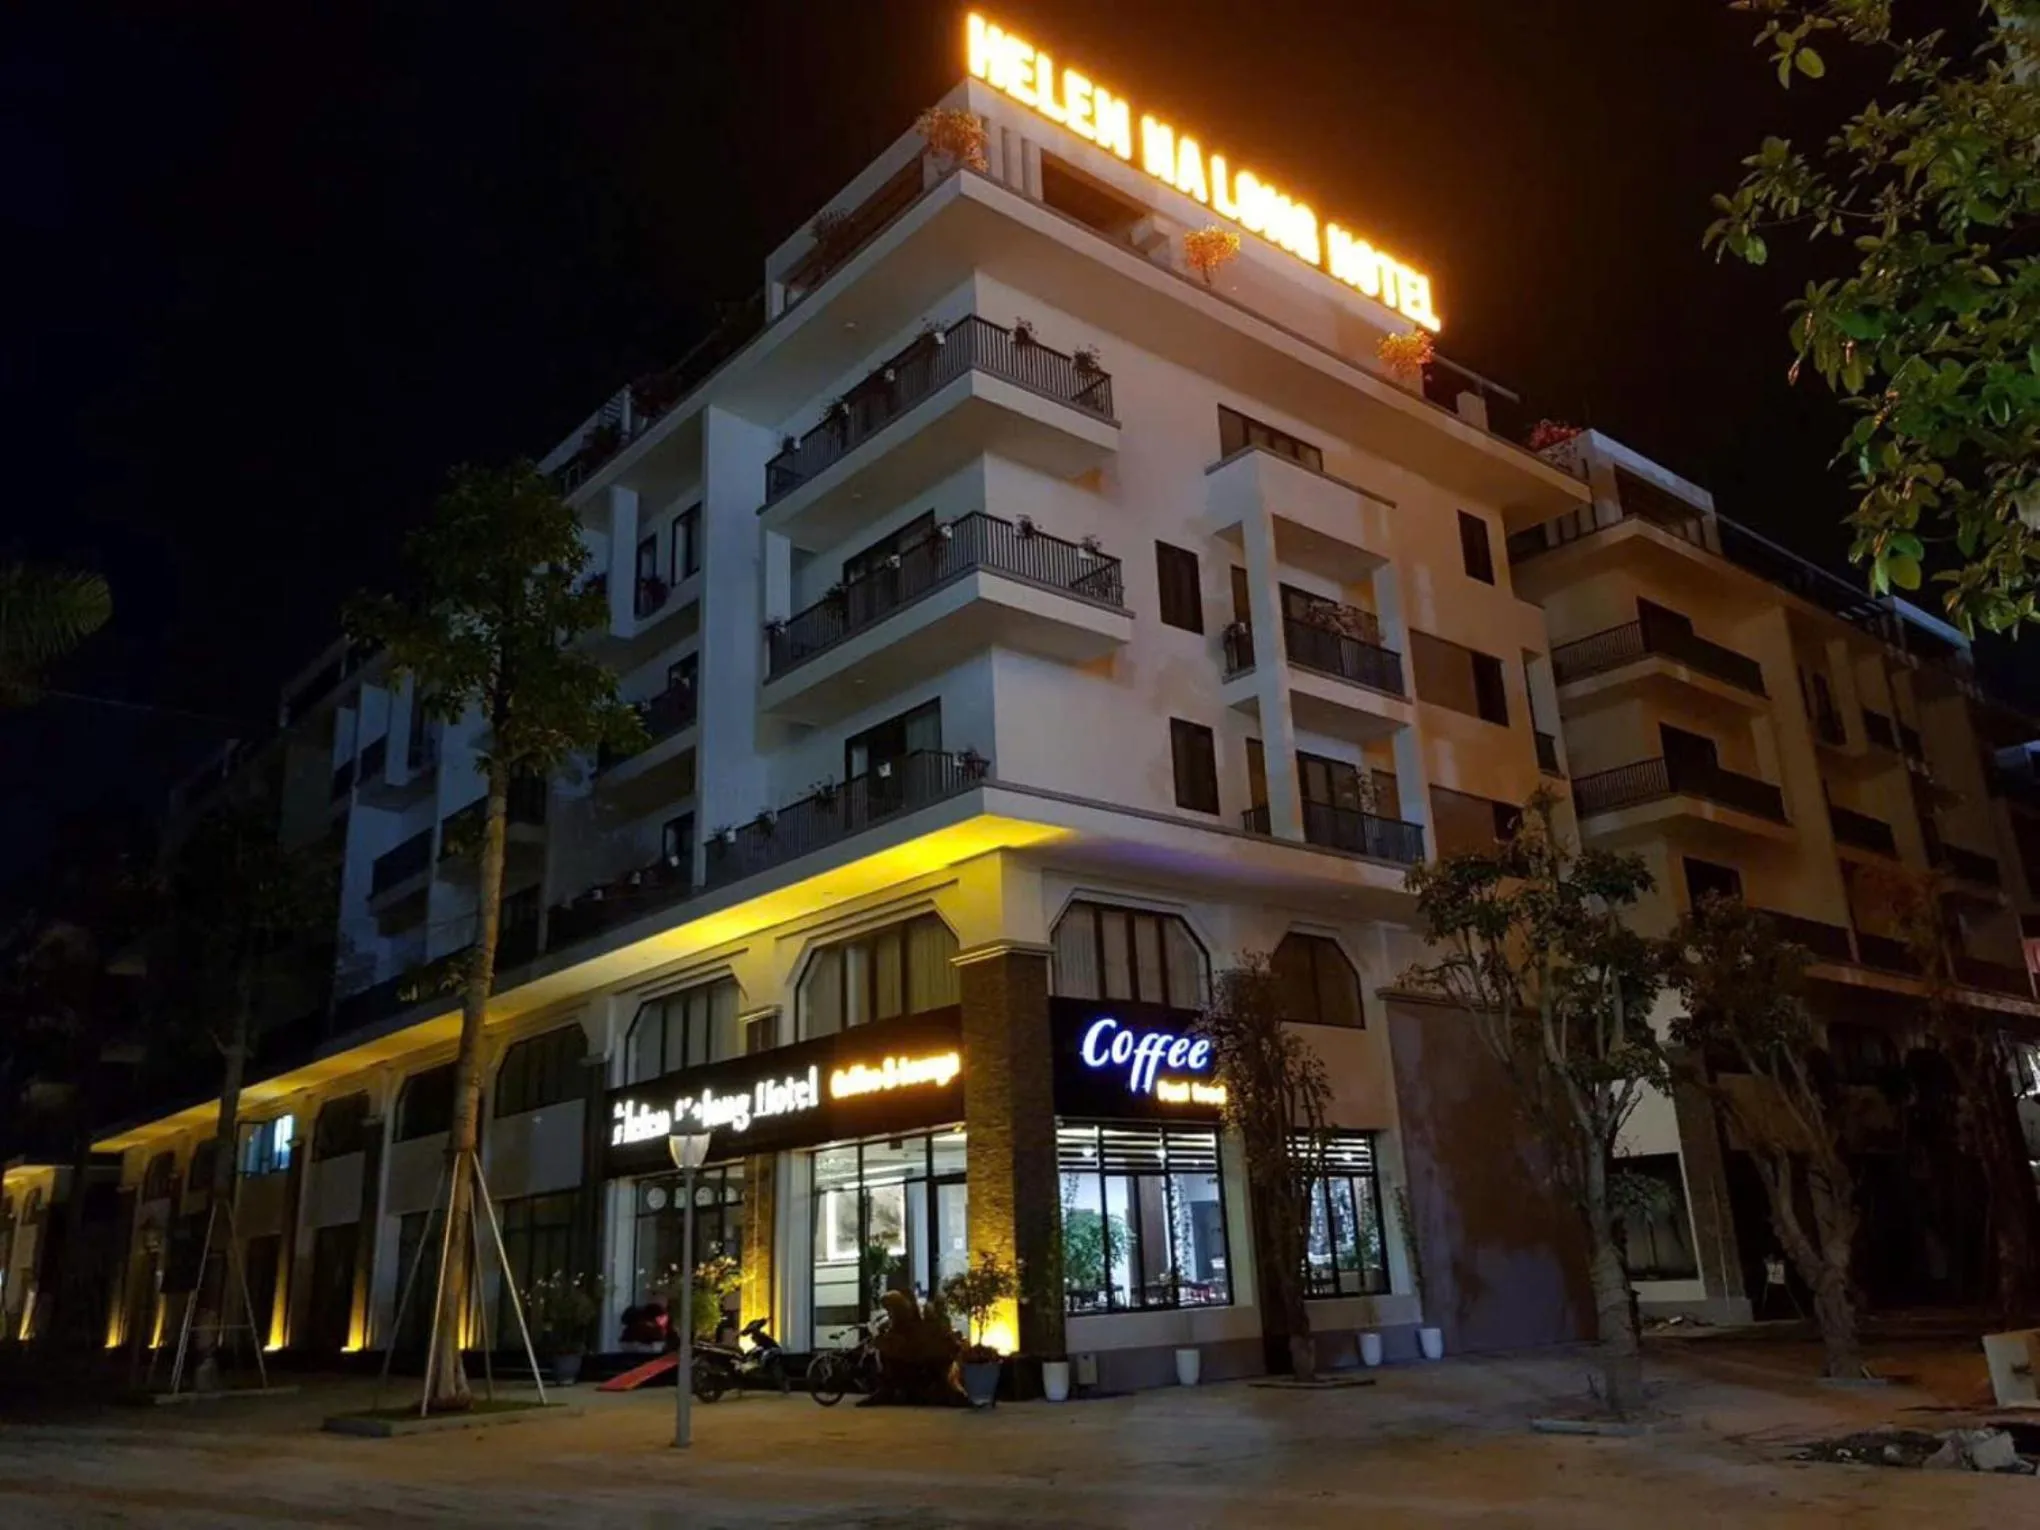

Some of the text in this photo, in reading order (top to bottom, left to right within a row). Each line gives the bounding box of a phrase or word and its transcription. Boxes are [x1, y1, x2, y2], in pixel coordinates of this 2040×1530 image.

[967, 12, 1132, 161] HELEN
[1326, 221, 1442, 334] HOTEL
[753, 1065, 819, 1118] Hotel
[1081, 1018, 1210, 1093] Coffee
